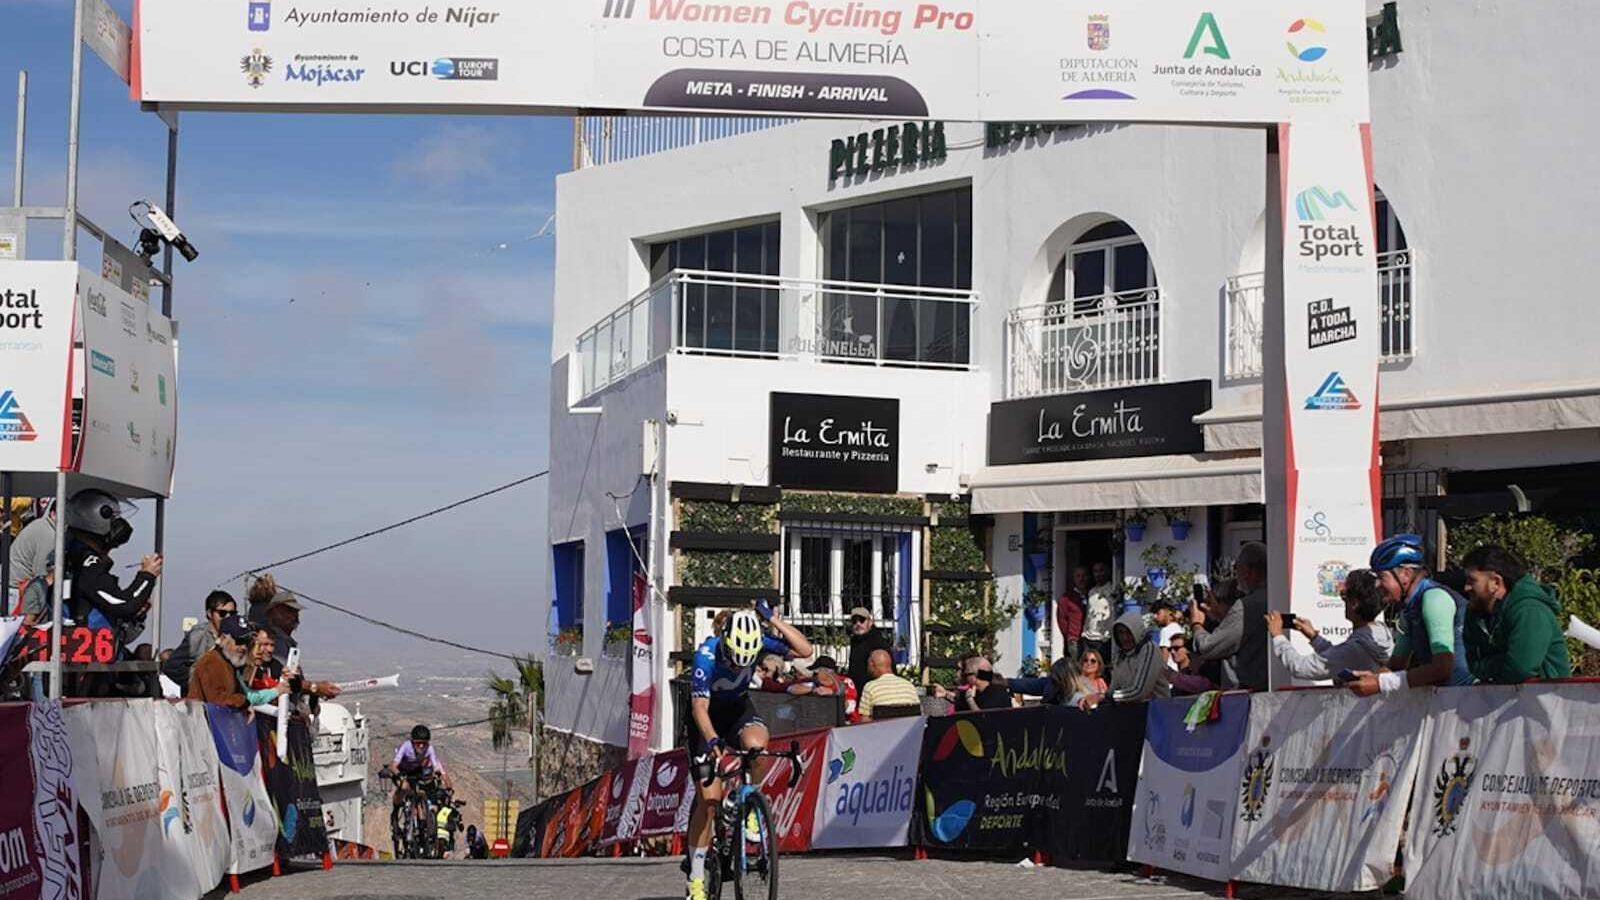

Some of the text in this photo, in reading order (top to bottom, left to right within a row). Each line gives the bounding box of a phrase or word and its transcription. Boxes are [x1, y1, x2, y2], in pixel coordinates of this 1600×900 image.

[284, 7, 500, 28] Ayuntamiento de Níjar
[602, 0, 974, 35] III Women Cycling Pro
[663, 36, 909, 65] COSTA DE ALMERÍA
[390, 60, 427, 76] UCI
[459, 61, 494, 70] EUROPE
[459, 69, 483, 77] TOUR
[1060, 57, 1138, 69] DIPUTACIÓN
[1152, 64, 1186, 76] Junta
[1188, 65, 1202, 75] de
[286, 63, 365, 86] Mojácar
[1062, 71, 1137, 82] DE ALMERÍA
[686, 81, 733, 97] META
[747, 83, 803, 99] FINISH
[817, 86, 888, 102] ARRIVAL
[1299, 225, 1359, 241] Total
[1299, 241, 1363, 261] Sport
[1310, 300, 1331, 315] C.D.
[1310, 311, 1348, 331] A TODA
[1310, 324, 1356, 346] MARCHA
[1037, 399, 1143, 443] La Ermita
[783, 416, 889, 448] La Ermita
[782, 447, 841, 459] Restaurante
[843, 452, 850, 462] y
[836, 765, 913, 826] aqualia
[980, 814, 1024, 830] DEPORTE
